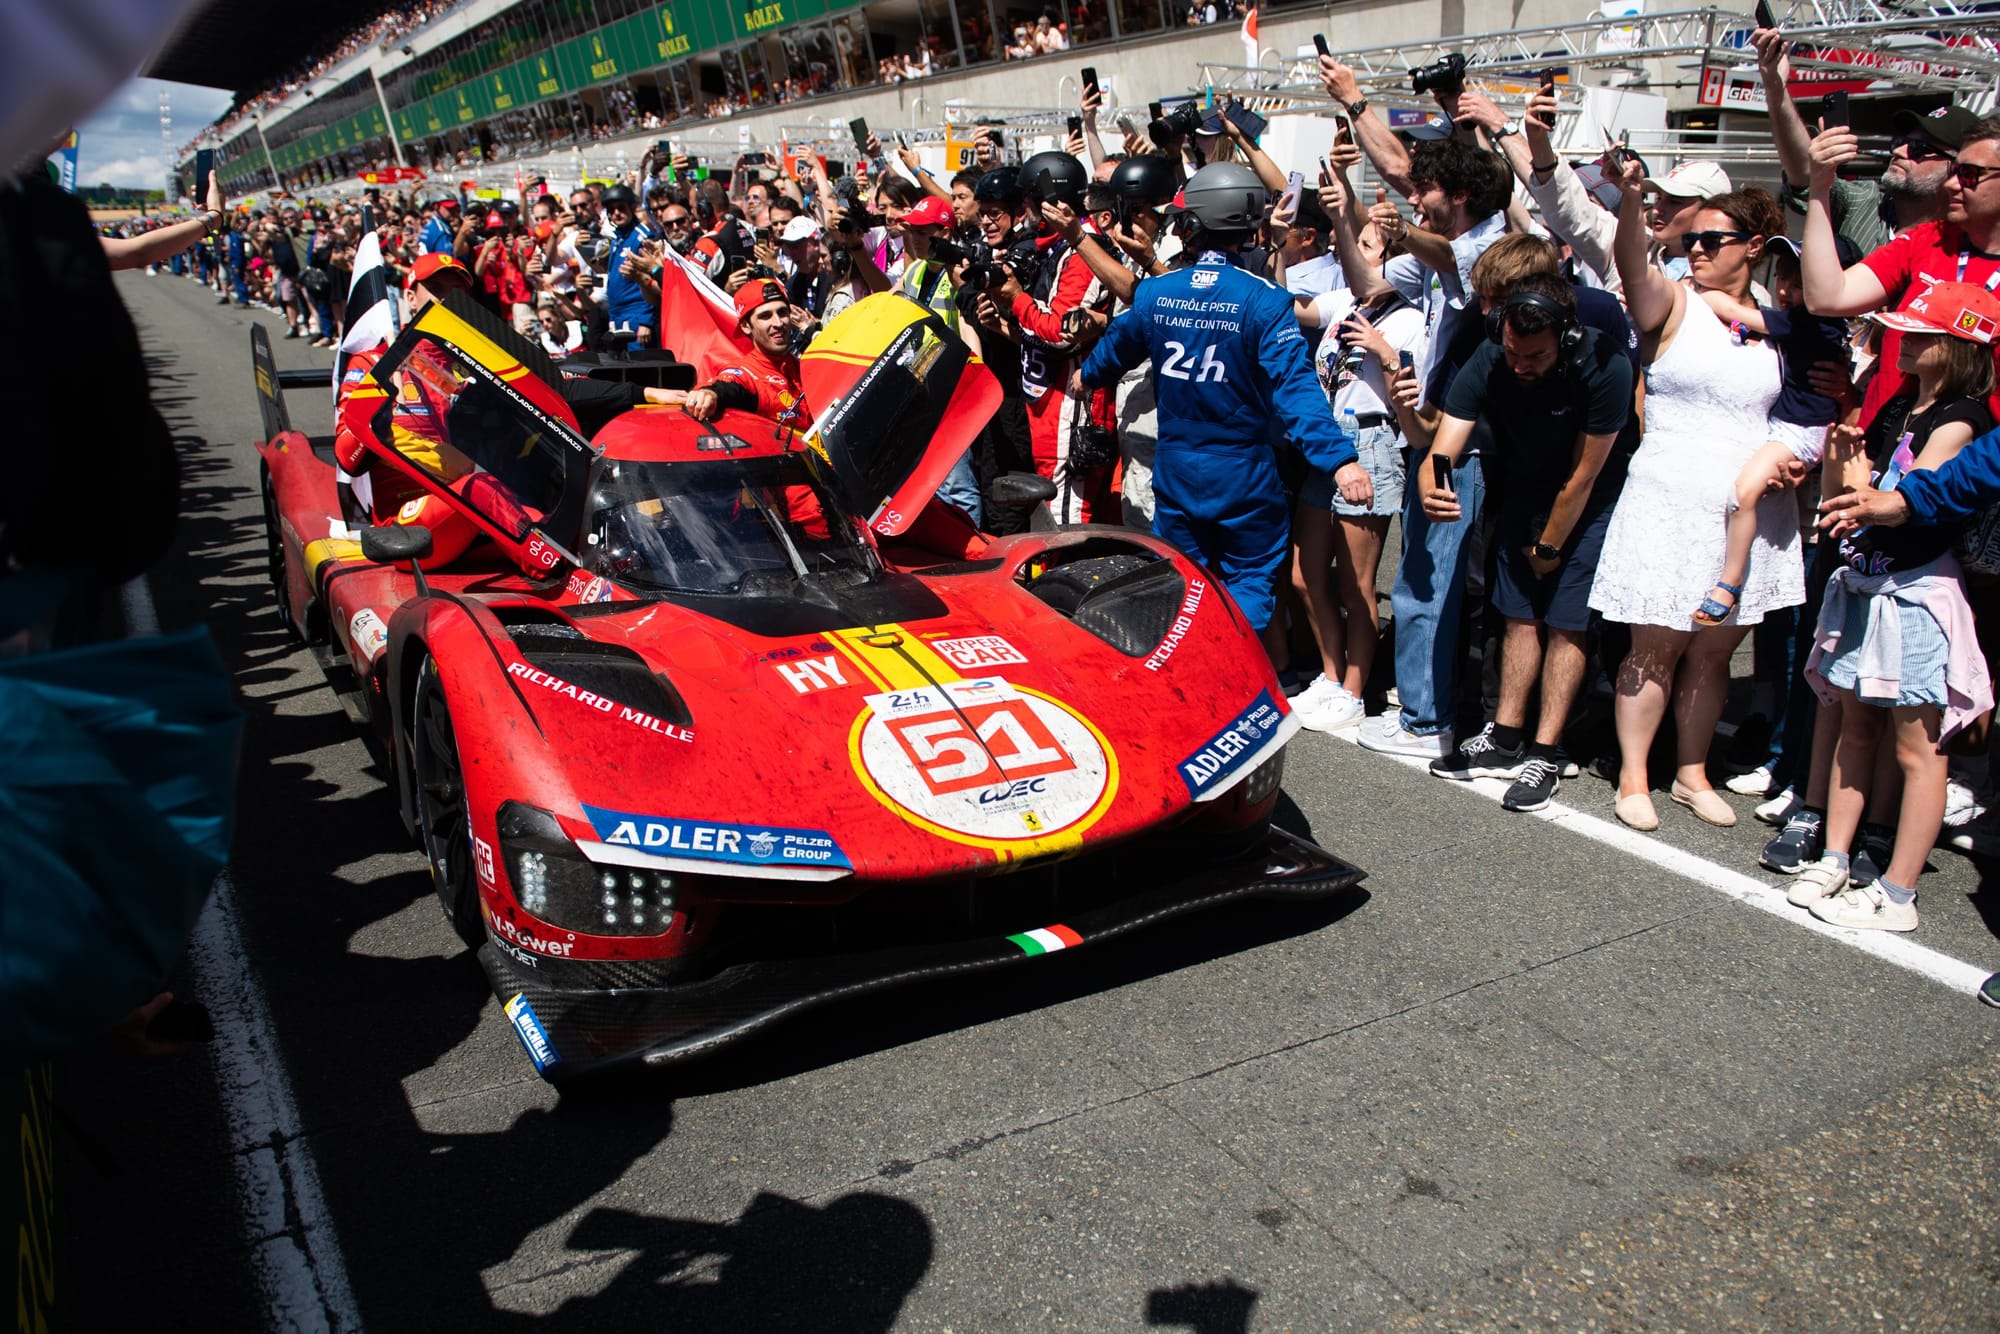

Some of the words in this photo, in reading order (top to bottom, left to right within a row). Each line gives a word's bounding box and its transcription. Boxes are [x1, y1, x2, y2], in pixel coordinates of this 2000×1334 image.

[744, 3, 784, 31] ROLEX
[657, 34, 690, 58] ROLEX
[1704, 70, 1723, 104] 8
[1729, 87, 1751, 101] GR
[961, 149, 975, 165] 91
[1191, 272, 1219, 284] OMP
[1157, 296, 1207, 312] CONTRÔLE
[1208, 301, 1240, 314] PISTE
[1165, 316, 1193, 329] LANE
[1194, 319, 1241, 333] CONTROL
[459, 353, 476, 367] PIER
[474, 365, 494, 381] GUIDI
[506, 389, 534, 412] CALADO
[547, 421, 583, 452] GIOVINAZZI
[1144, 615, 1193, 671] RICHARD
[1182, 579, 1206, 617] MILLE
[938, 636, 1006, 651] HYPER
[950, 646, 1022, 666] CAR
[776, 655, 849, 694] HY
[507, 662, 614, 712] RICHARD
[619, 707, 695, 743] MILLE
[1248, 704, 1271, 723] PELZER
[1258, 711, 1280, 730] GROUP
[900, 710, 1063, 784] 51
[1184, 730, 1250, 787] ADLER
[979, 777, 1046, 804] WEC
[605, 821, 742, 854] ADLER
[783, 835, 832, 848] PELZER
[783, 847, 832, 860] GROUP
[517, 1011, 556, 1067] MICHELIN
